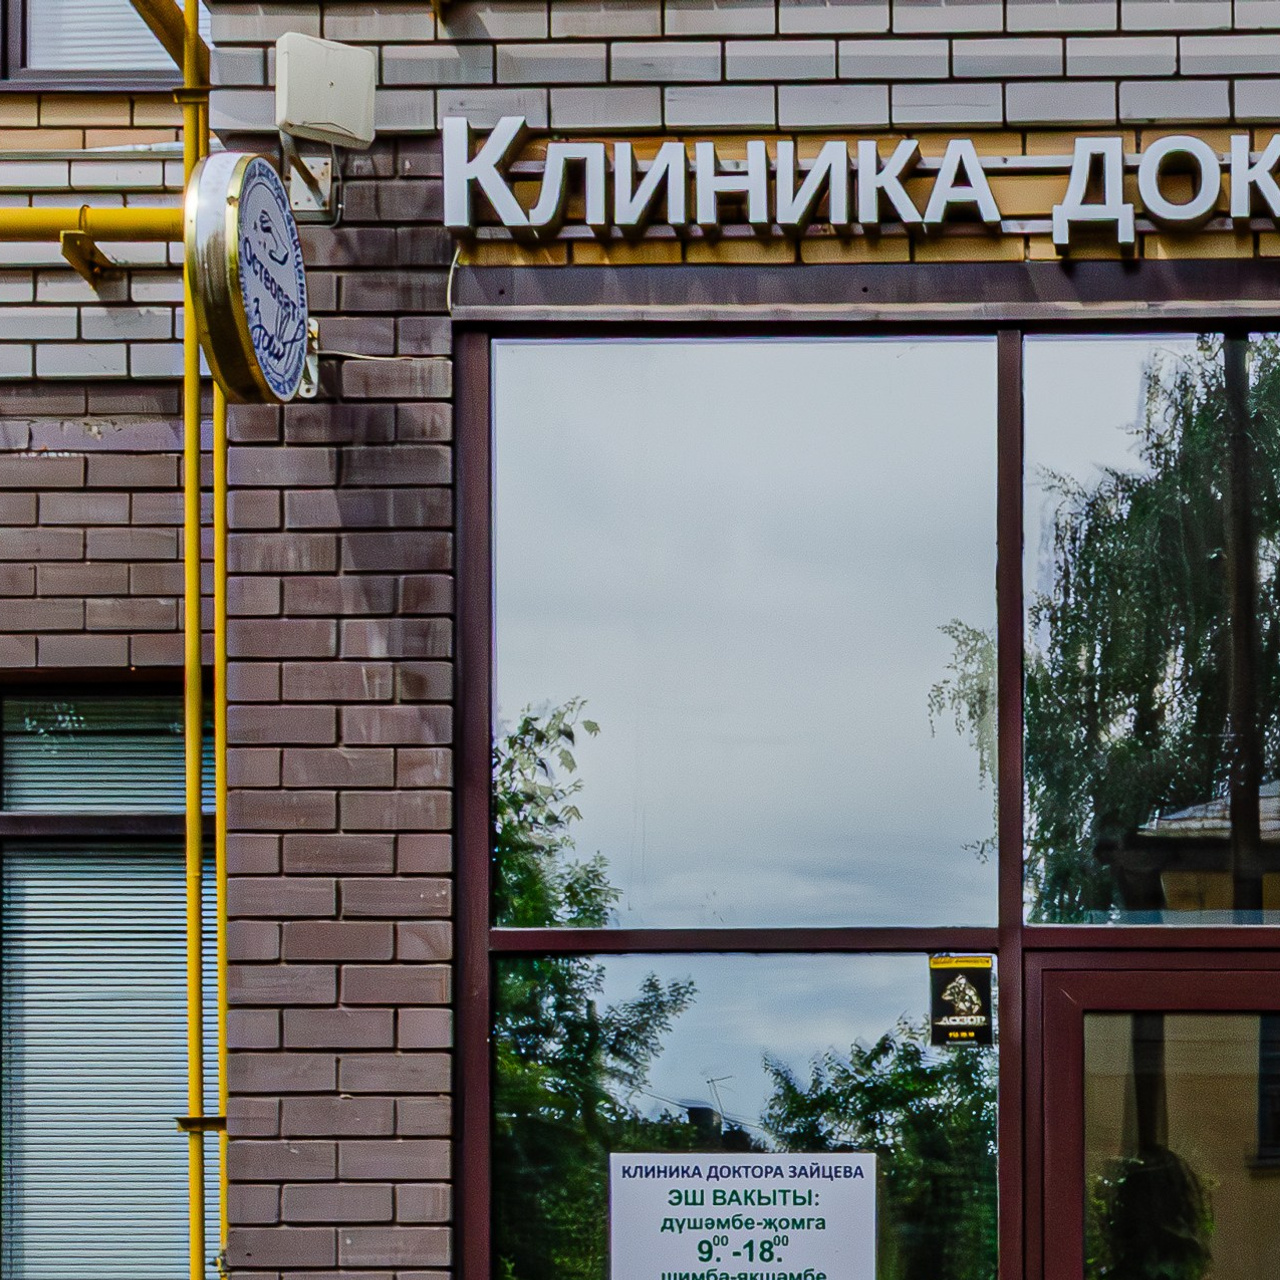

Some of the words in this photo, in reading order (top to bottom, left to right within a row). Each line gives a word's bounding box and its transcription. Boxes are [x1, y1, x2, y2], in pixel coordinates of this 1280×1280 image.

[621, 1165, 703, 1179] КЛИНИКА
[705, 1165, 785, 1182] ДОКТОРА
[788, 1162, 865, 1182] ЗАЙЦЕВА
[667, 1188, 705, 1207] ЭШ
[712, 1188, 820, 1207] ВАКЫТЫ:
[660, 1213, 826, 1235] дүшәмбе-җомга
